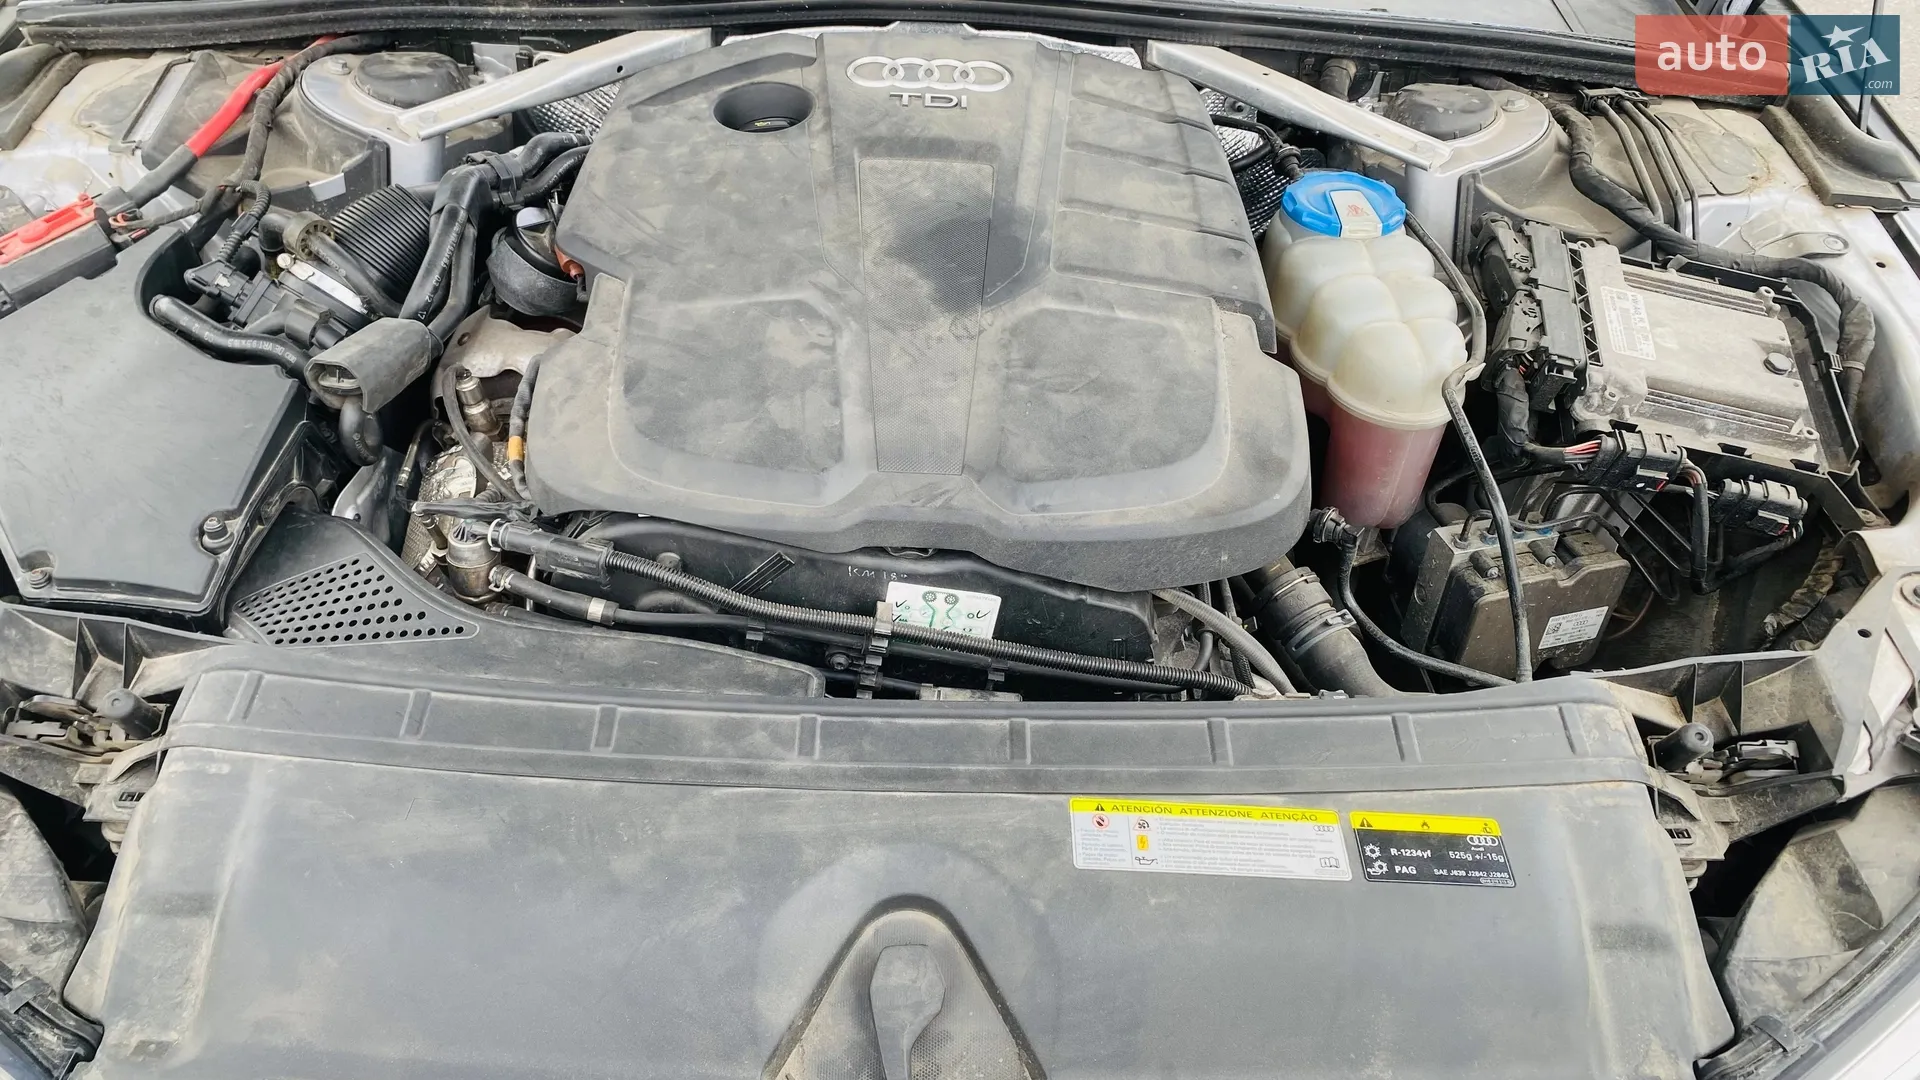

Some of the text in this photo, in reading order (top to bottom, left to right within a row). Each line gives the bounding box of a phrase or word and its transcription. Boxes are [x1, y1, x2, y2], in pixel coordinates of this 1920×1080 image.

[889, 91, 968, 110] TDI
[1111, 804, 1173, 815] ATENCIÓN
[1180, 807, 1254, 819] ATTENZIONE
[1390, 847, 1432, 859] R-1234yf
[1448, 851, 1473, 861] 525g
[1394, 865, 1417, 875] PAG
[1433, 868, 1448, 876] SAE
